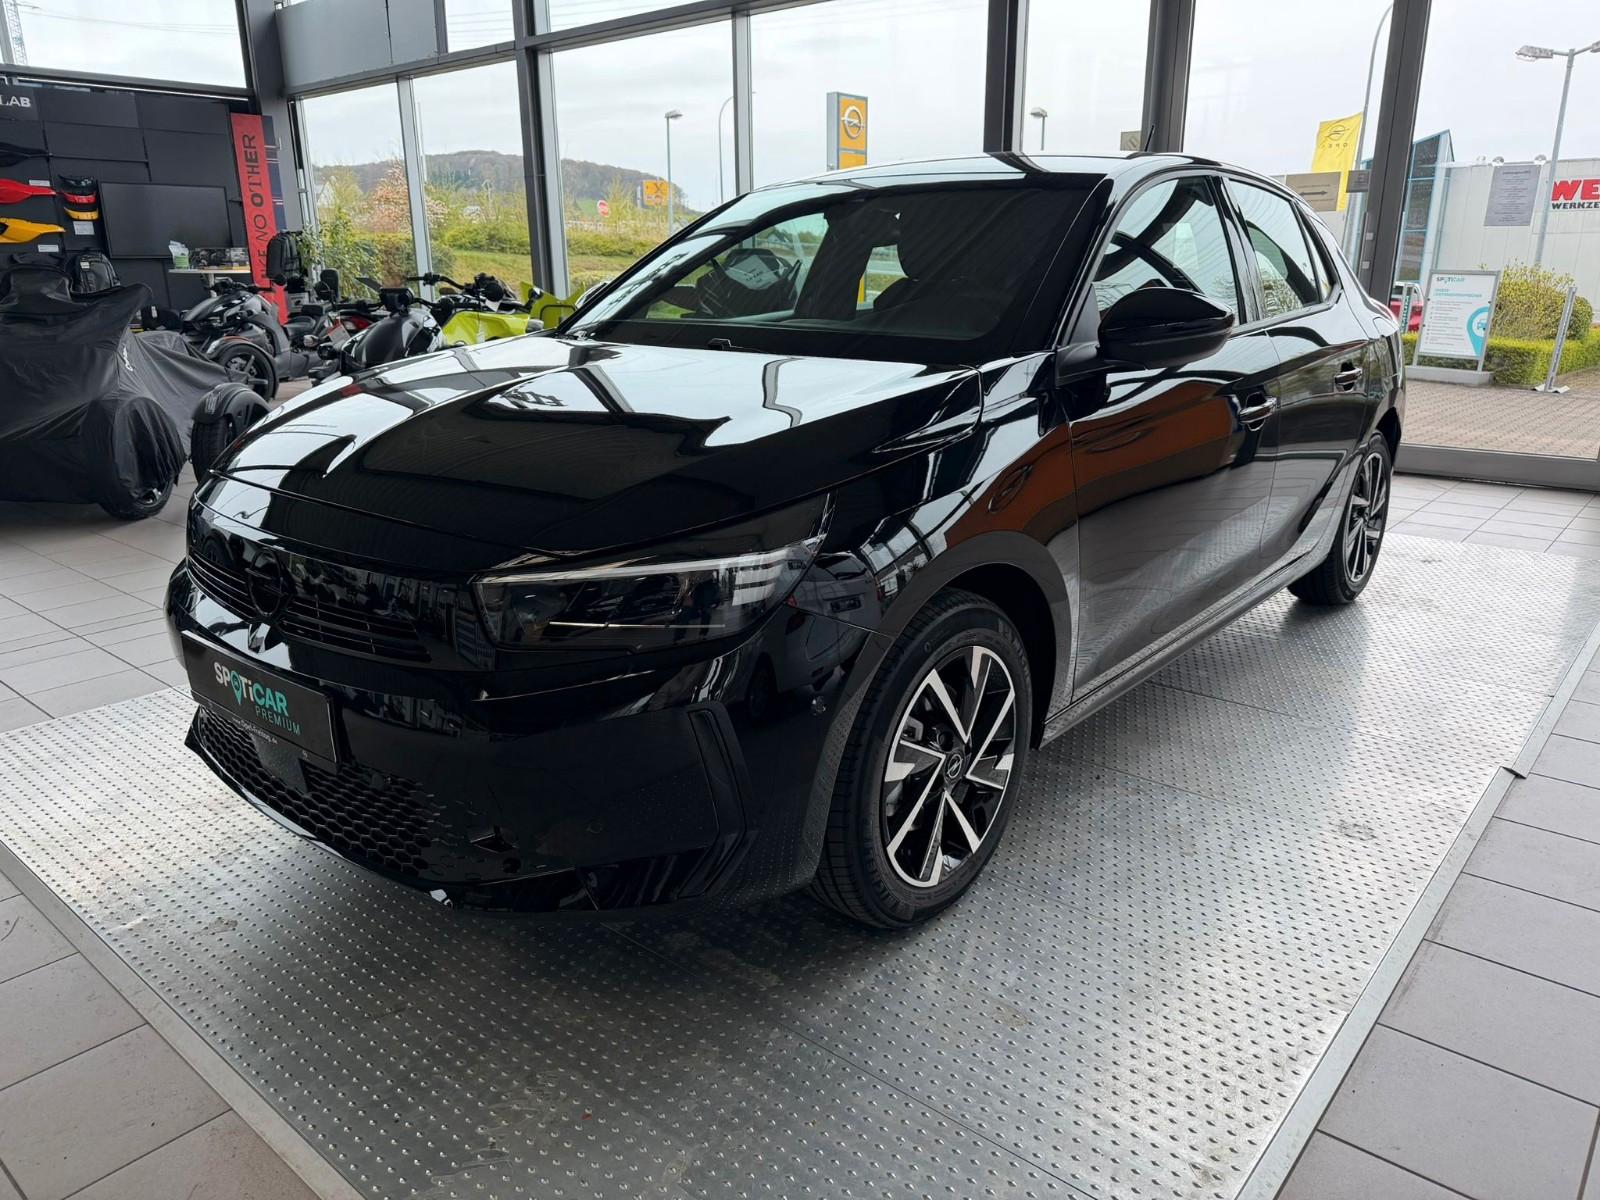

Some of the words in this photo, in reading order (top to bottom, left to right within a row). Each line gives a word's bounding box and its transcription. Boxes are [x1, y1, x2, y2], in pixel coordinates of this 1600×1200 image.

[242, 134, 264, 207] OTHER
[253, 214, 269, 240] NO
[255, 705, 300, 735] PREMIUM
